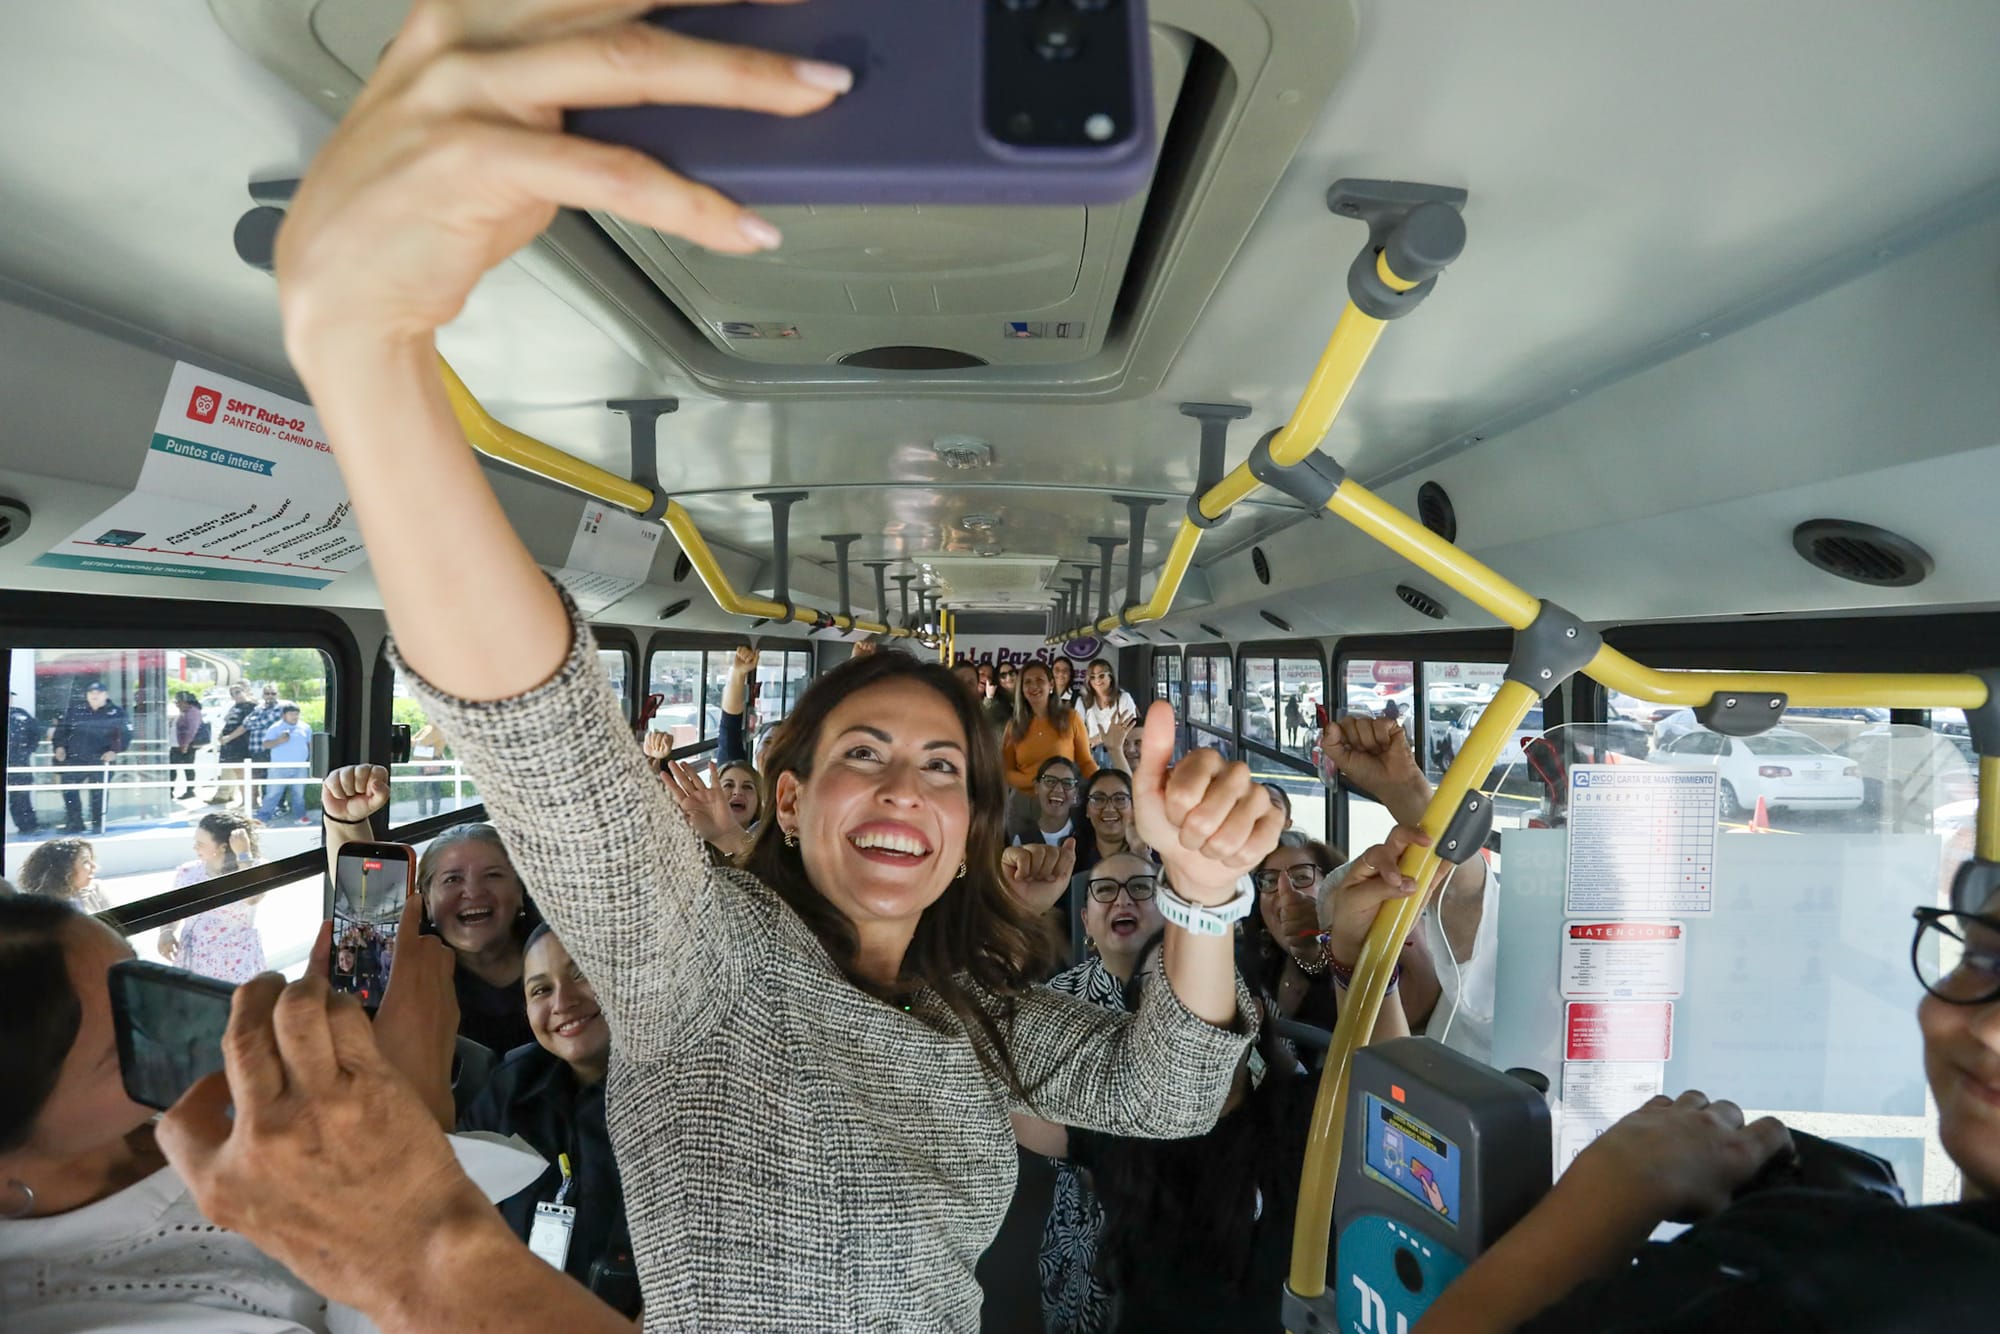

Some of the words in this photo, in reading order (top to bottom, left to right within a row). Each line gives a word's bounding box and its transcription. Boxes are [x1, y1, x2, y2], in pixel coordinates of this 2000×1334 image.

[222, 414, 271, 437] PANTEÓN
[277, 430, 314, 448] CAMINO
[226, 398, 256, 416] SMT
[256, 407, 305, 432] Ruta-02
[165, 439, 209, 459] Puntos
[210, 450, 225, 463] de
[227, 454, 265, 473] interés
[166, 519, 219, 541] Panteón
[221, 511, 236, 520] de
[170, 536, 190, 545] los
[191, 525, 216, 536] San
[219, 503, 258, 527] Juanes
[201, 528, 248, 548] Colegio
[231, 530, 281, 552] Mercado
[281, 512, 310, 532] Bravo
[262, 531, 314, 552] Comisión
[314, 502, 344, 532] Federal
[266, 548, 280, 556] de
[281, 516, 342, 550] Electricidad
[296, 542, 330, 557] Teatro
[970, 646, 993, 666] La
[996, 647, 1034, 667] Paz
[1035, 648, 1056, 667] Sí
[1591, 774, 1613, 783] AYCO
[1616, 775, 1641, 785] CARTA
[1642, 775, 1652, 785] DE
[1653, 775, 1713, 785] MANTENIMIENTO
[1575, 792, 1651, 802] CONCEPTO
